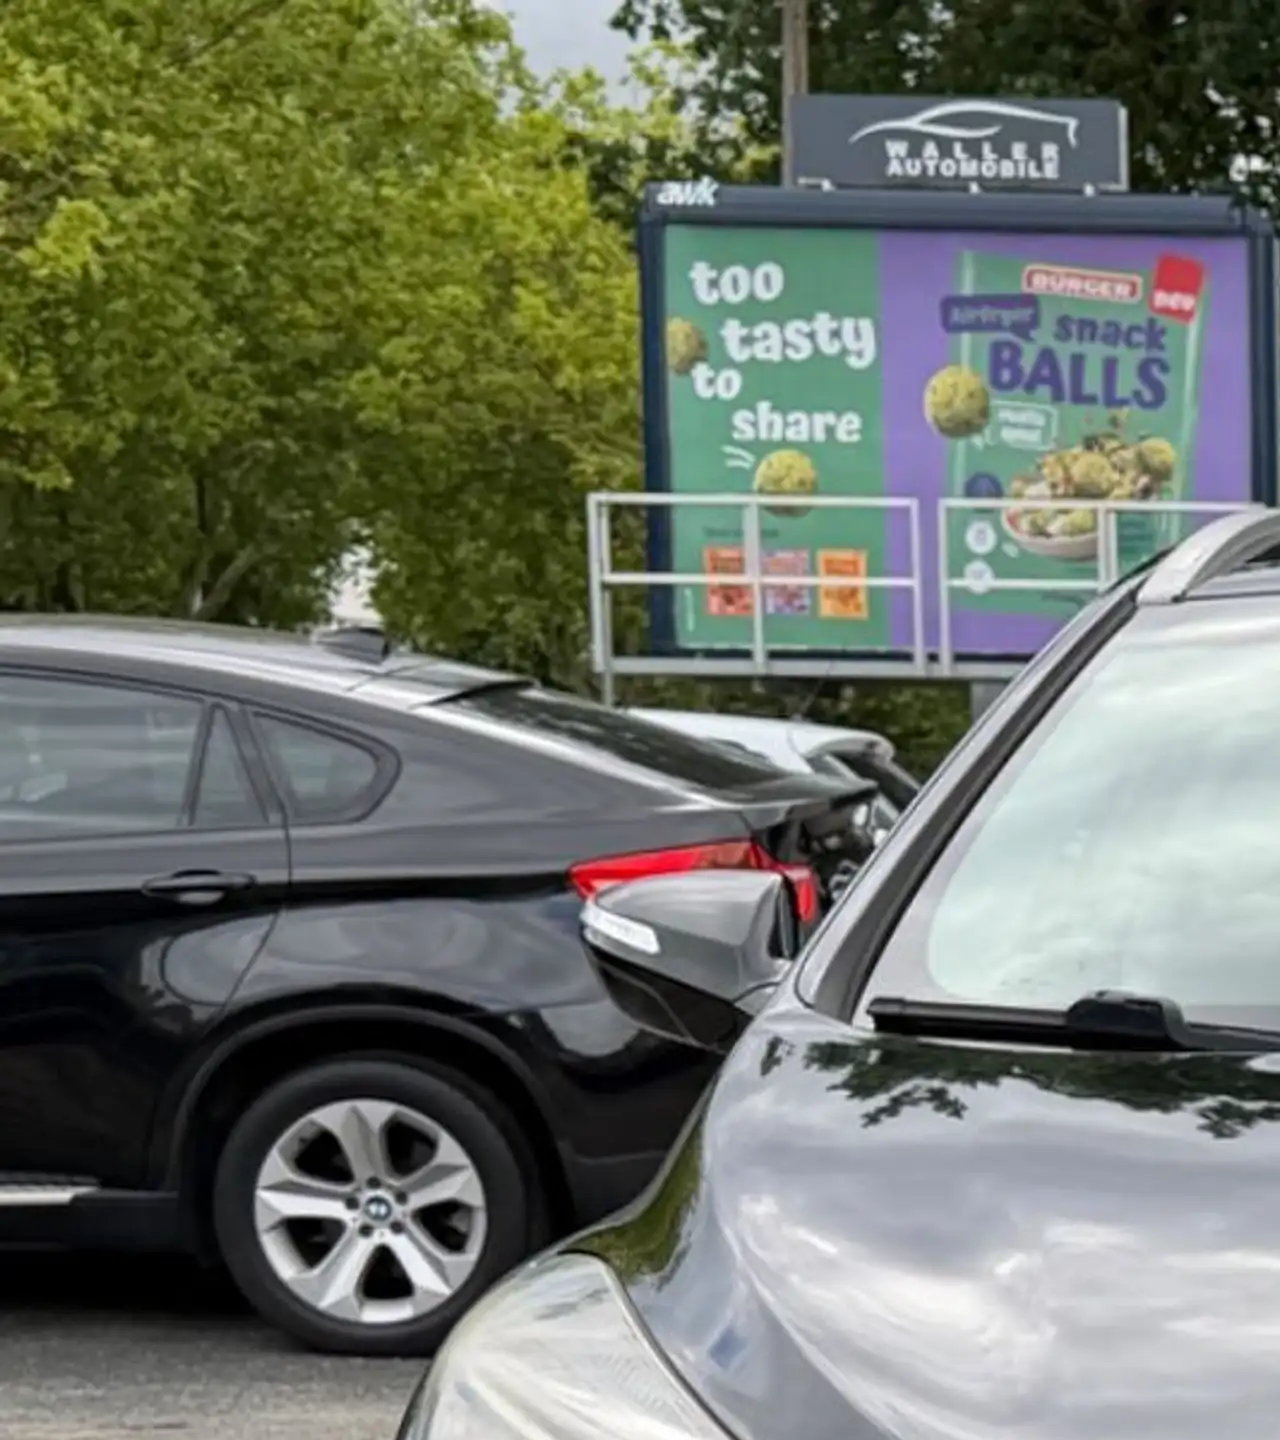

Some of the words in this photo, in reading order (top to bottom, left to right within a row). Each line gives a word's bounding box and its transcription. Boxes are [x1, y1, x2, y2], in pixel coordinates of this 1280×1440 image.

[884, 140, 1060, 160] WALLER
[885, 159, 1060, 179] AUTOMOBILE
[688, 261, 785, 305] too
[720, 312, 877, 370] tasty
[1053, 314, 1168, 352] snack
[690, 361, 743, 400] to
[988, 339, 1170, 411] BALLS
[731, 400, 864, 443] share
